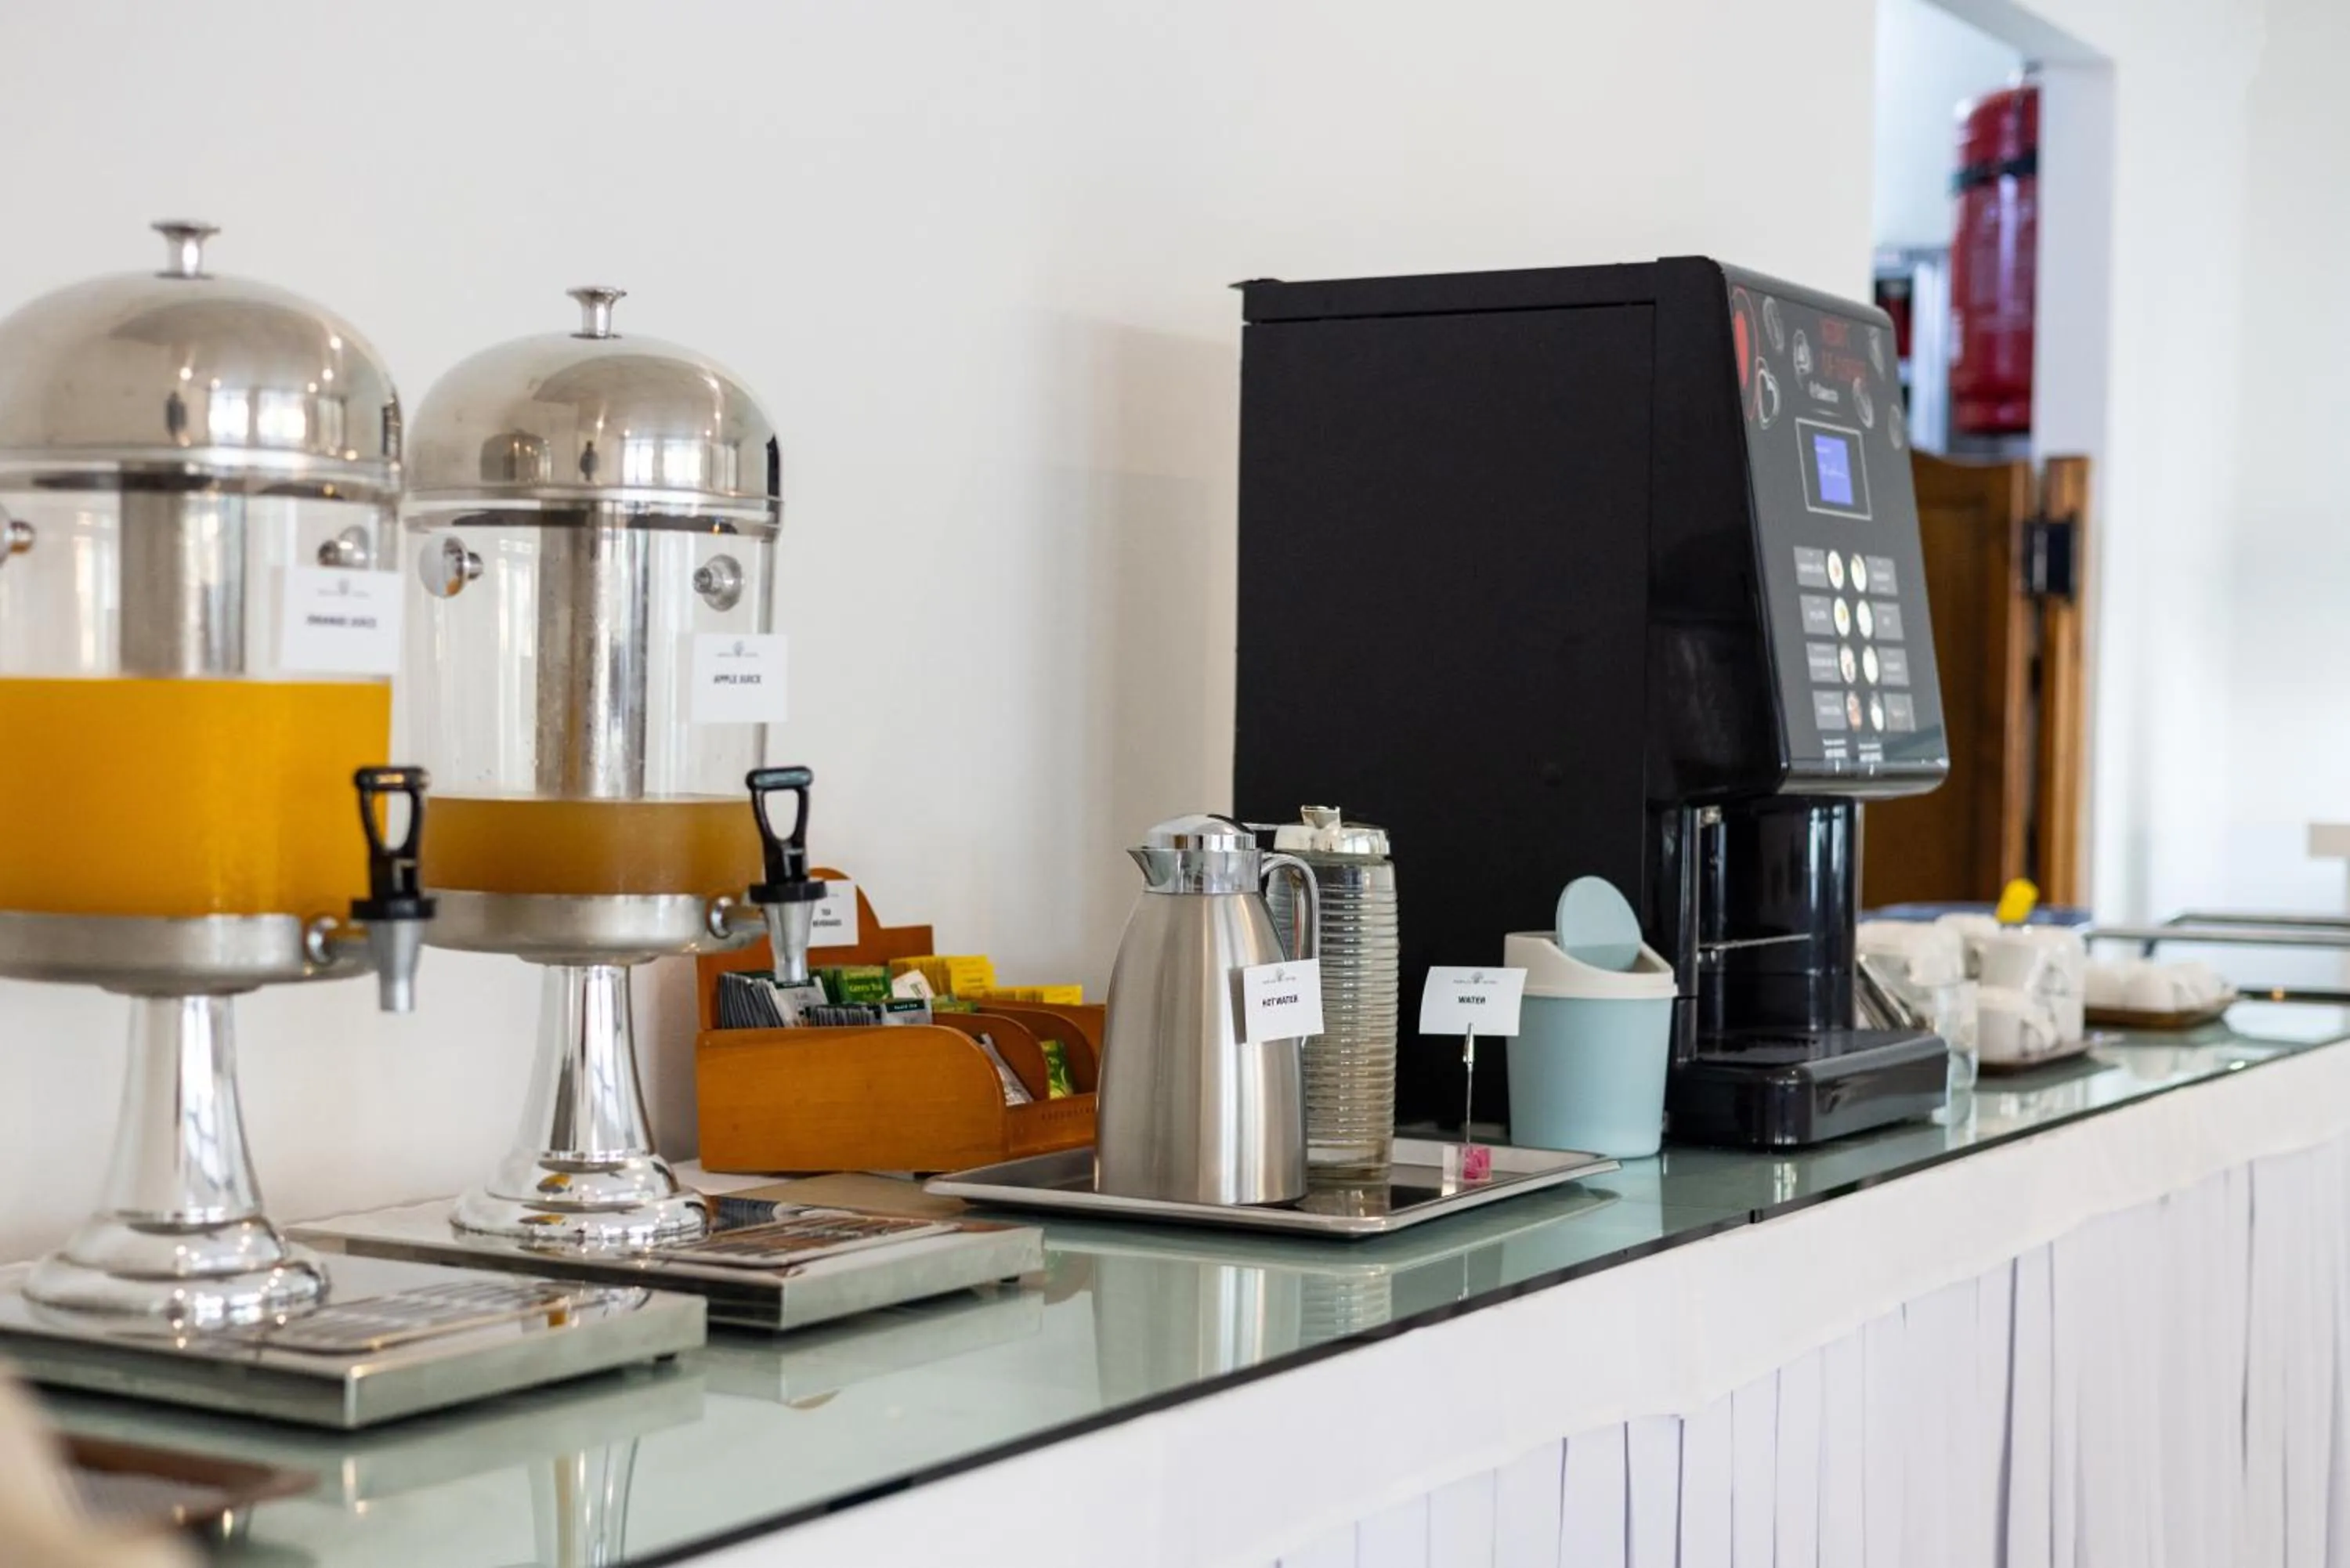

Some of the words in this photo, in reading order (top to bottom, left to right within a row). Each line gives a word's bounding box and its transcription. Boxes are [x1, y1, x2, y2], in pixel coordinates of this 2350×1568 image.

[713, 674, 738, 685] APPLE
[739, 674, 762, 685] JUICE
[1262, 997, 1276, 1007] HOT
[1276, 994, 1299, 1006] WATER
[1458, 995, 1486, 1005] WATER
